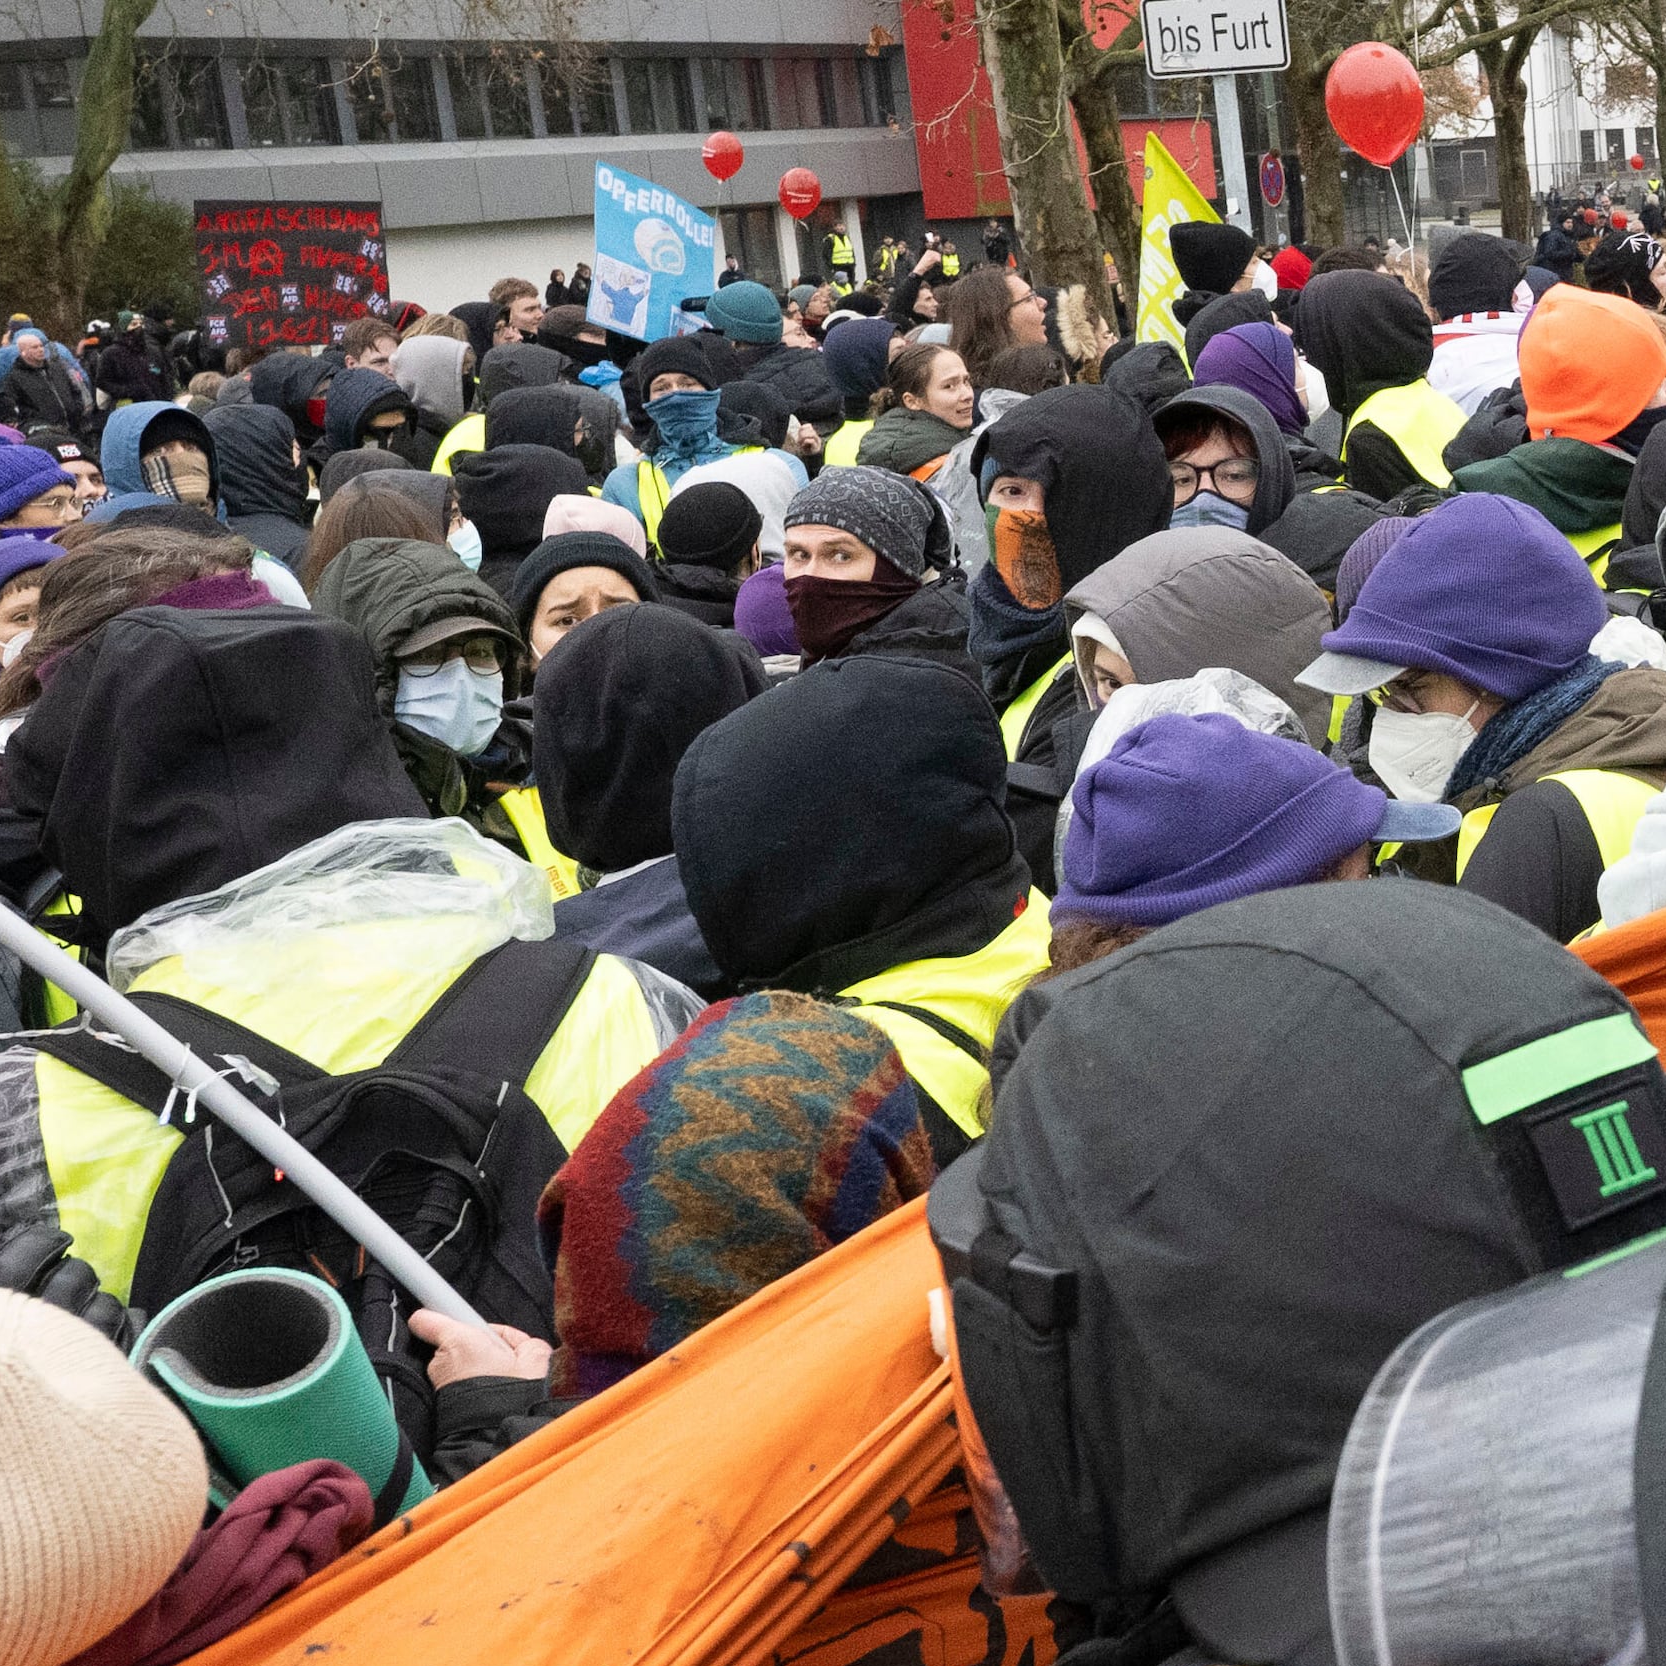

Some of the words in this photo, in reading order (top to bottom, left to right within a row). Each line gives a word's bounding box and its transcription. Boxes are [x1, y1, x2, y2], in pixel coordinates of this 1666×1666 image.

[1158, 17, 1202, 54] bis
[1211, 11, 1272, 52] Furt
[1570, 1100, 1657, 1198] III
